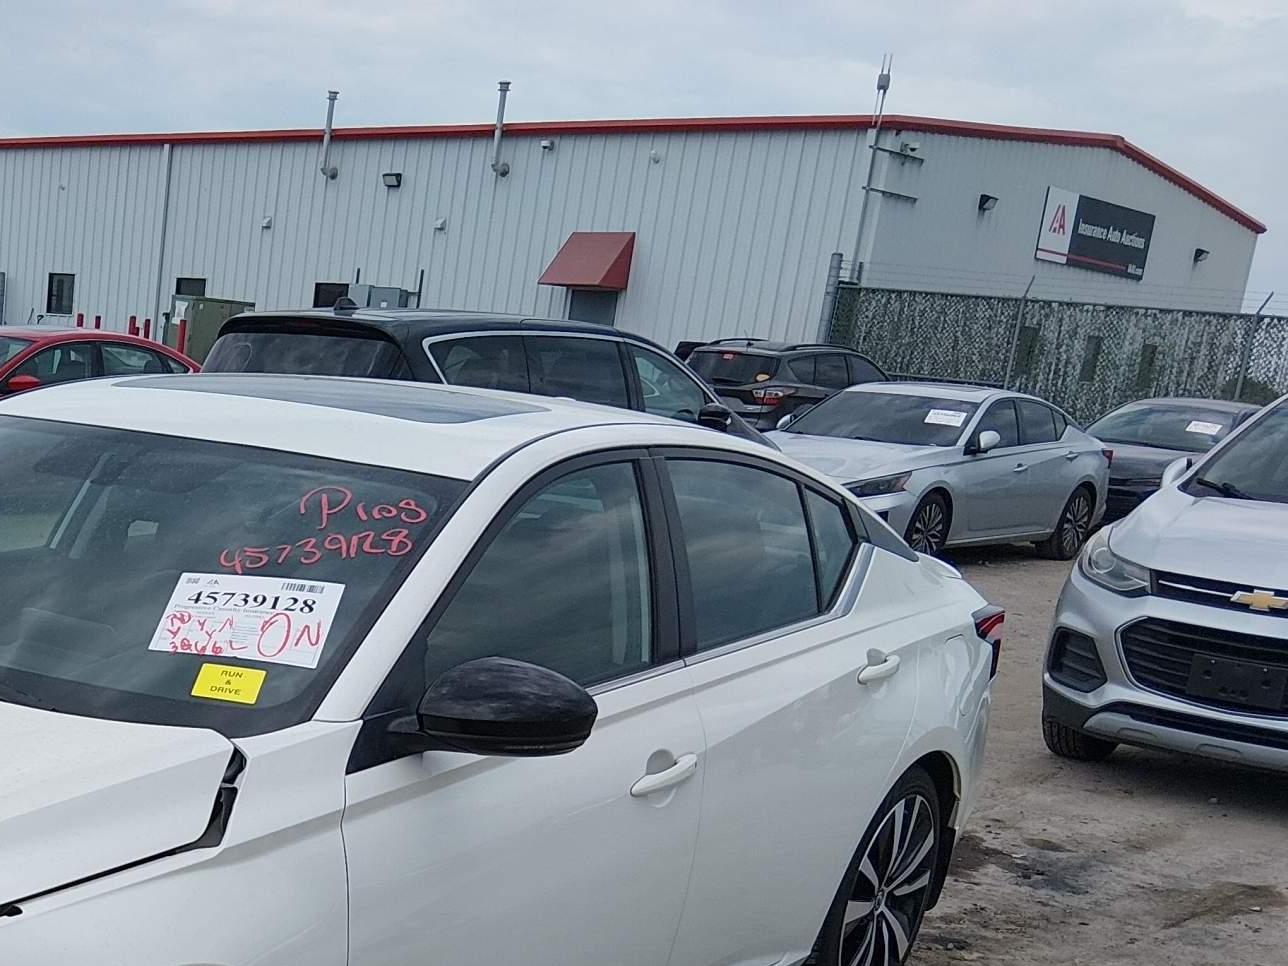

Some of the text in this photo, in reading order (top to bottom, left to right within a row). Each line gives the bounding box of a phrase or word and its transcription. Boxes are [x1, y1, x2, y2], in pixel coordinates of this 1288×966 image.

[1077, 218, 1146, 249] Insurance Auto Auctions
[218, 528, 413, 575] 45739128
[187, 590, 317, 614] 45739128
[220, 670, 244, 678] RUN
[209, 685, 242, 696] DRIVE
